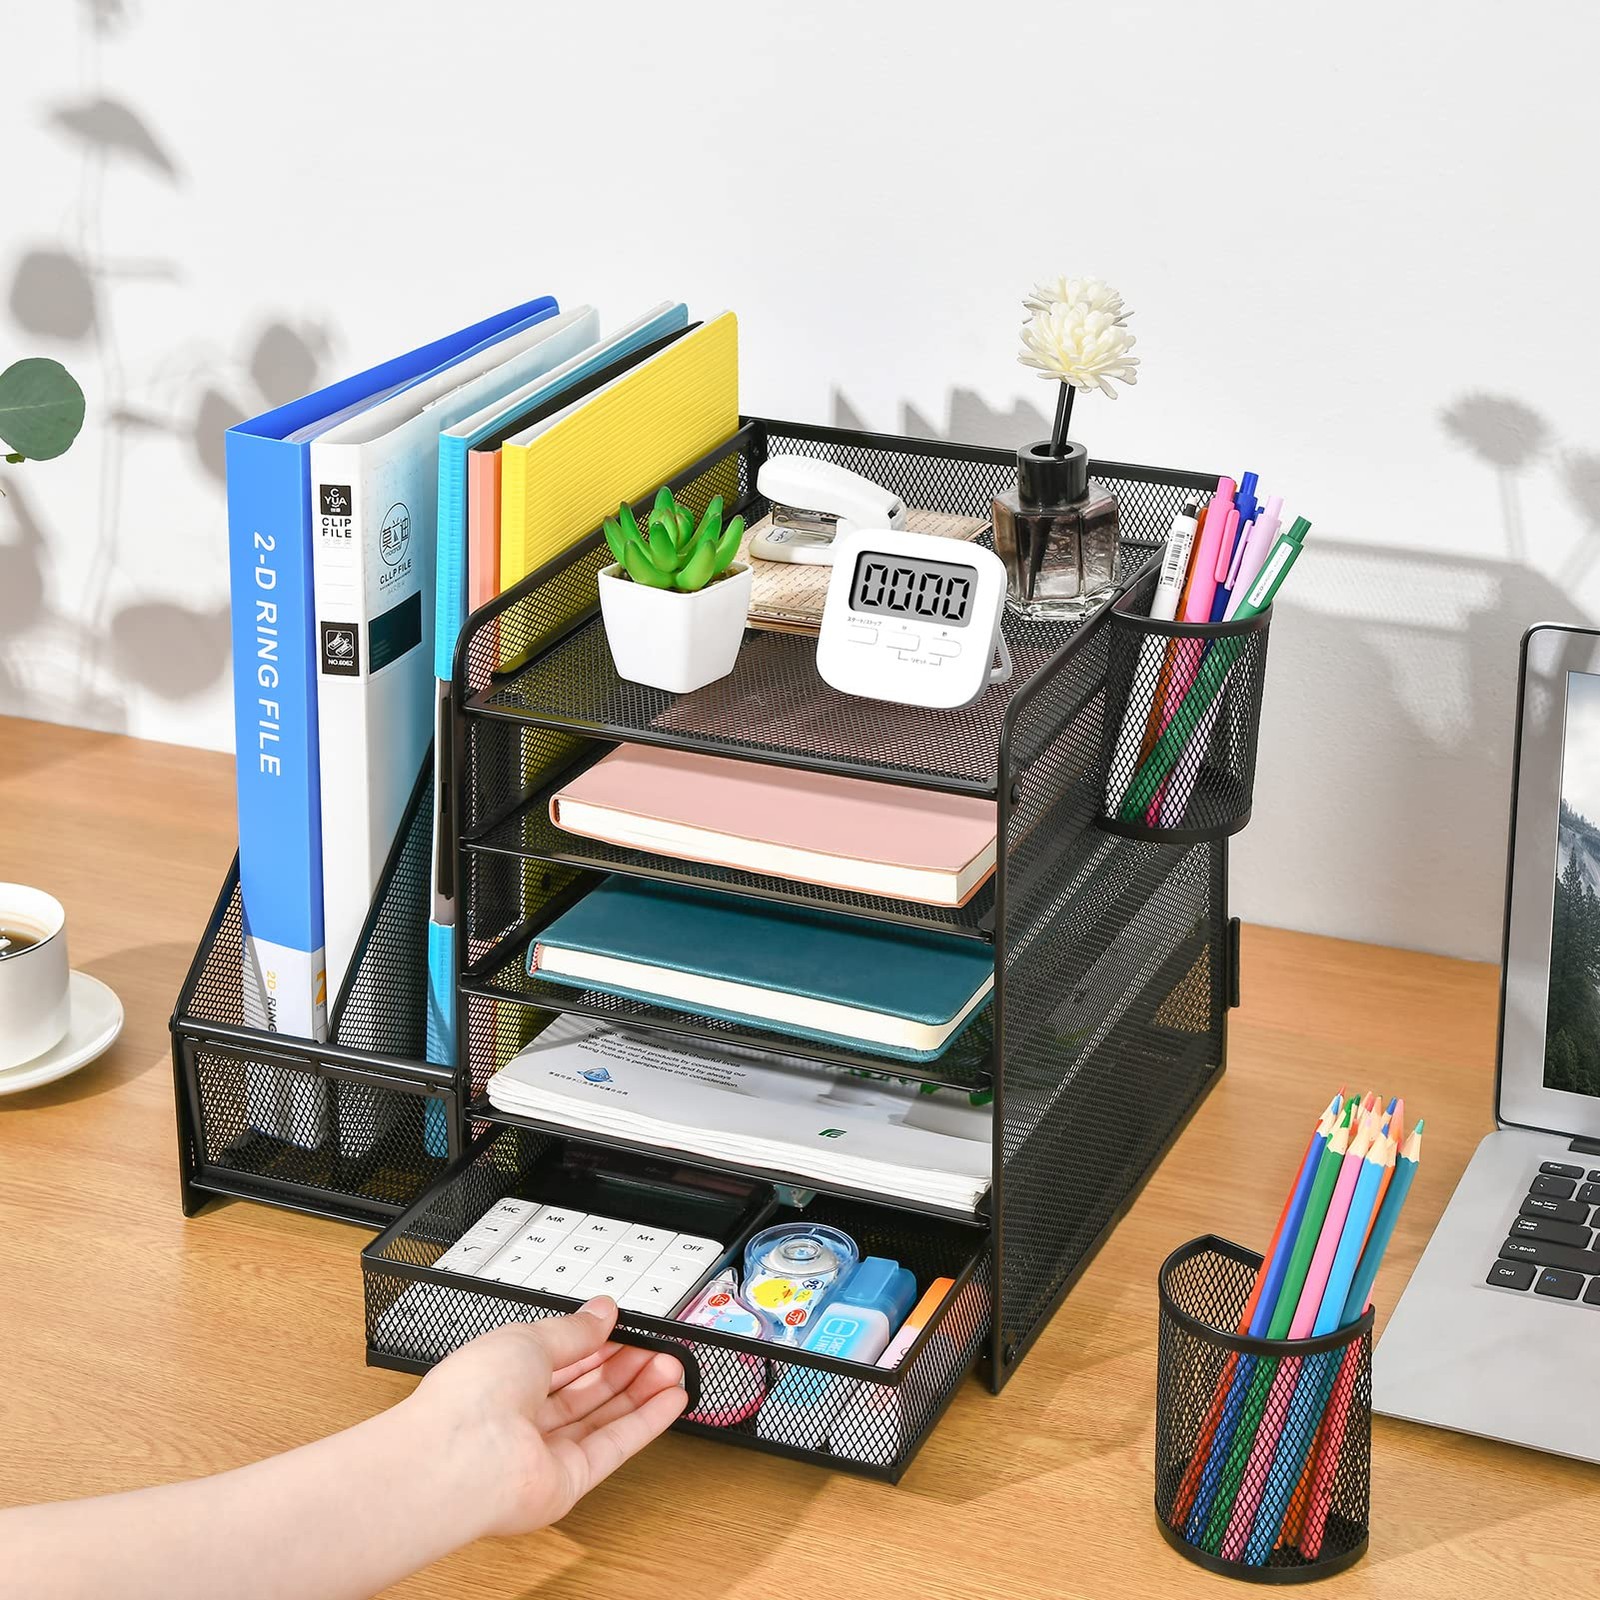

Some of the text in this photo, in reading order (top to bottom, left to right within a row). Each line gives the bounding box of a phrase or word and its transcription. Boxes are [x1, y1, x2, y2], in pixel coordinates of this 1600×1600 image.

[322, 517, 352, 527] CLIP
[322, 527, 352, 538] FILE
[861, 564, 970, 621] 0000
[253, 531, 281, 777] 2-D RING FILE
[577, 1043, 600, 1053] taking
[631, 1059, 673, 1073] perspective
[582, 1038, 600, 1047] daily
[600, 1043, 616, 1051] lives
[641, 1055, 660, 1063] basis
[706, 1071, 732, 1080] always
[600, 1037, 624, 1047] deliver
[625, 1045, 647, 1054] useful
[647, 1051, 679, 1062] products
[691, 1062, 733, 1075] considering
[500, 1205, 521, 1214] MC
[546, 1215, 565, 1223] MR
[526, 1235, 546, 1243] MU
[636, 1234, 655, 1242] M+
[573, 1245, 590, 1253] GT
[682, 1244, 704, 1252] OFF
[510, 1255, 521, 1263] 7
[622, 1254, 634, 1263] %
[555, 1265, 566, 1273] 8
[604, 1275, 615, 1283] 9
[806, 1280, 820, 1290] 36
